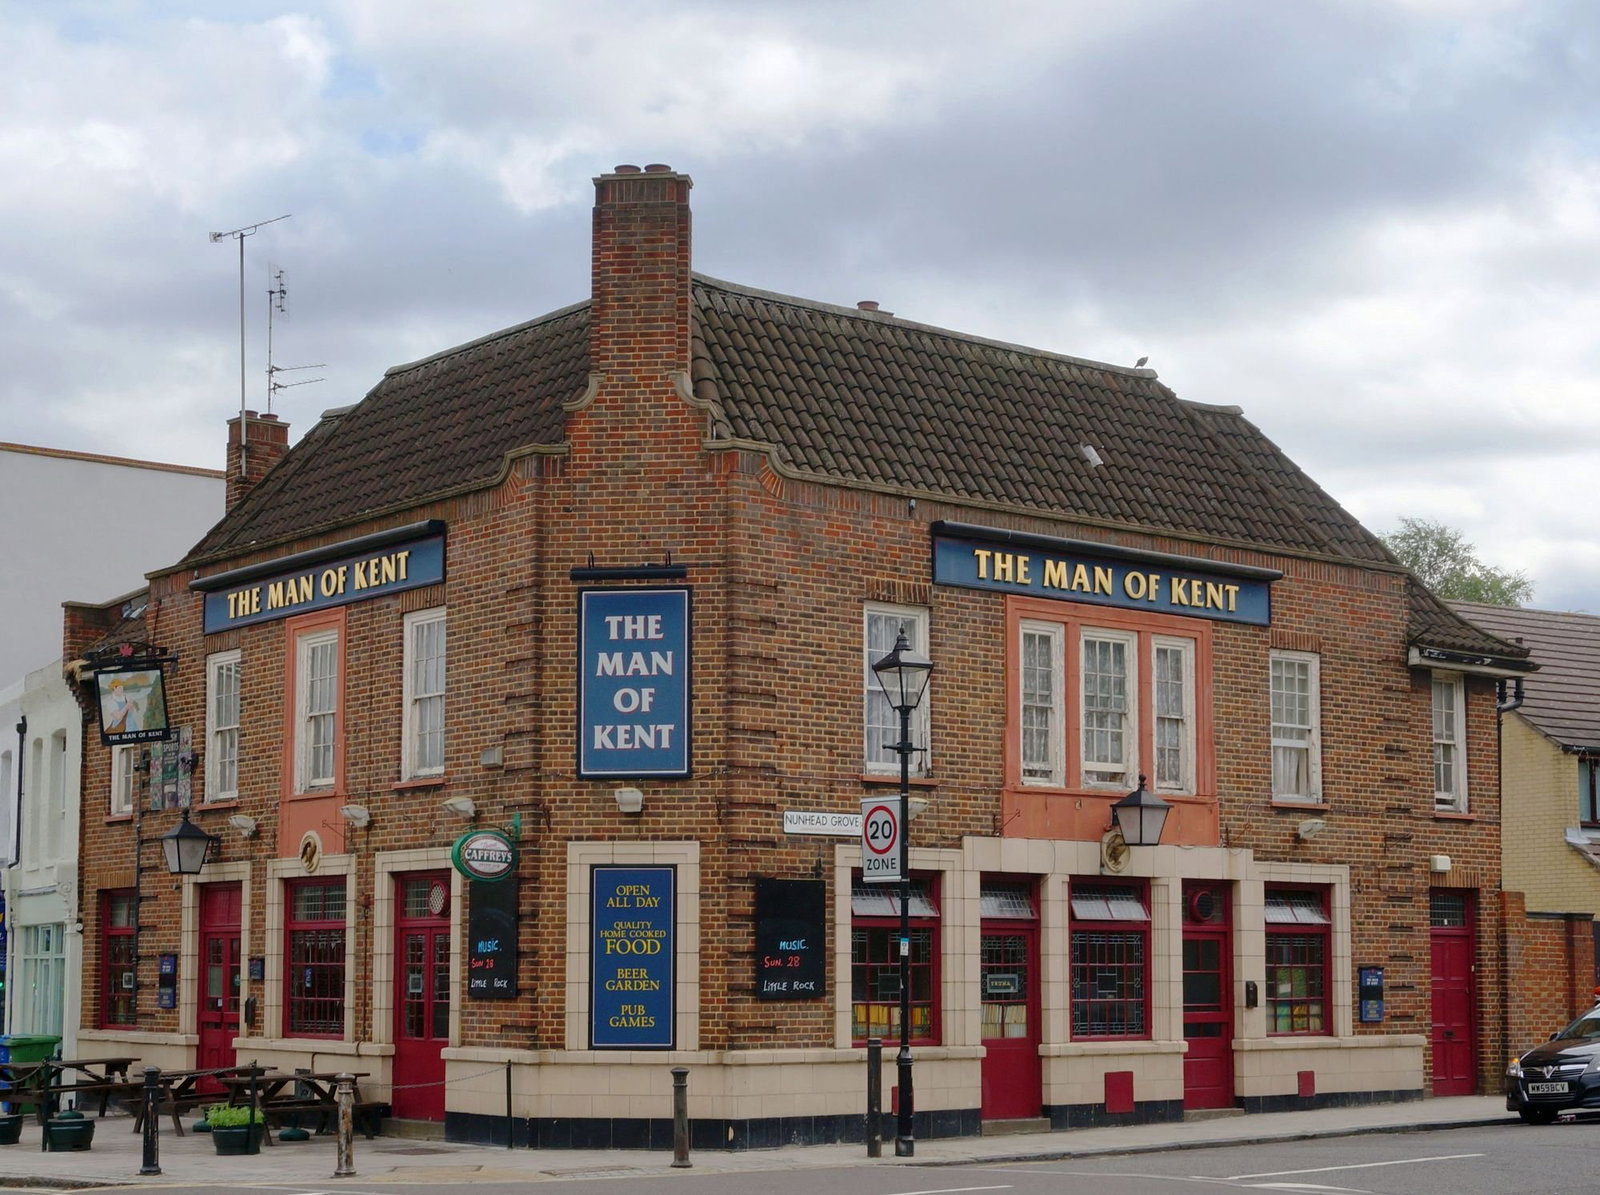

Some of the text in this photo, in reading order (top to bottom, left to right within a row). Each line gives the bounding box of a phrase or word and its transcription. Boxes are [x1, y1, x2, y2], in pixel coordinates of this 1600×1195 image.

[227, 550, 410, 619] THE MAN OF KENT
[974, 549, 1239, 612] THE MAN OF KENT
[604, 615, 664, 640] THE
[595, 651, 673, 676] MAN
[613, 687, 655, 713] OF
[121, 732, 137, 740] MAN
[593, 724, 675, 750] KENT
[785, 814, 859, 828] NUNHEAD GROVE
[869, 820, 893, 839] 20
[866, 858, 897, 870] ZONE
[616, 884, 651, 896] OPEN
[606, 896, 661, 908] ALL DAY
[613, 921, 653, 930] QUALITY
[600, 930, 667, 938] HOME COOKED
[605, 938, 661, 955] FOOD
[485, 959, 495, 969] 28
[786, 956, 801, 968] 28
[616, 968, 649, 979] BEER
[605, 979, 660, 991] GARDEN
[621, 1004, 646, 1016] PUB
[608, 1016, 656, 1027] GAMES
